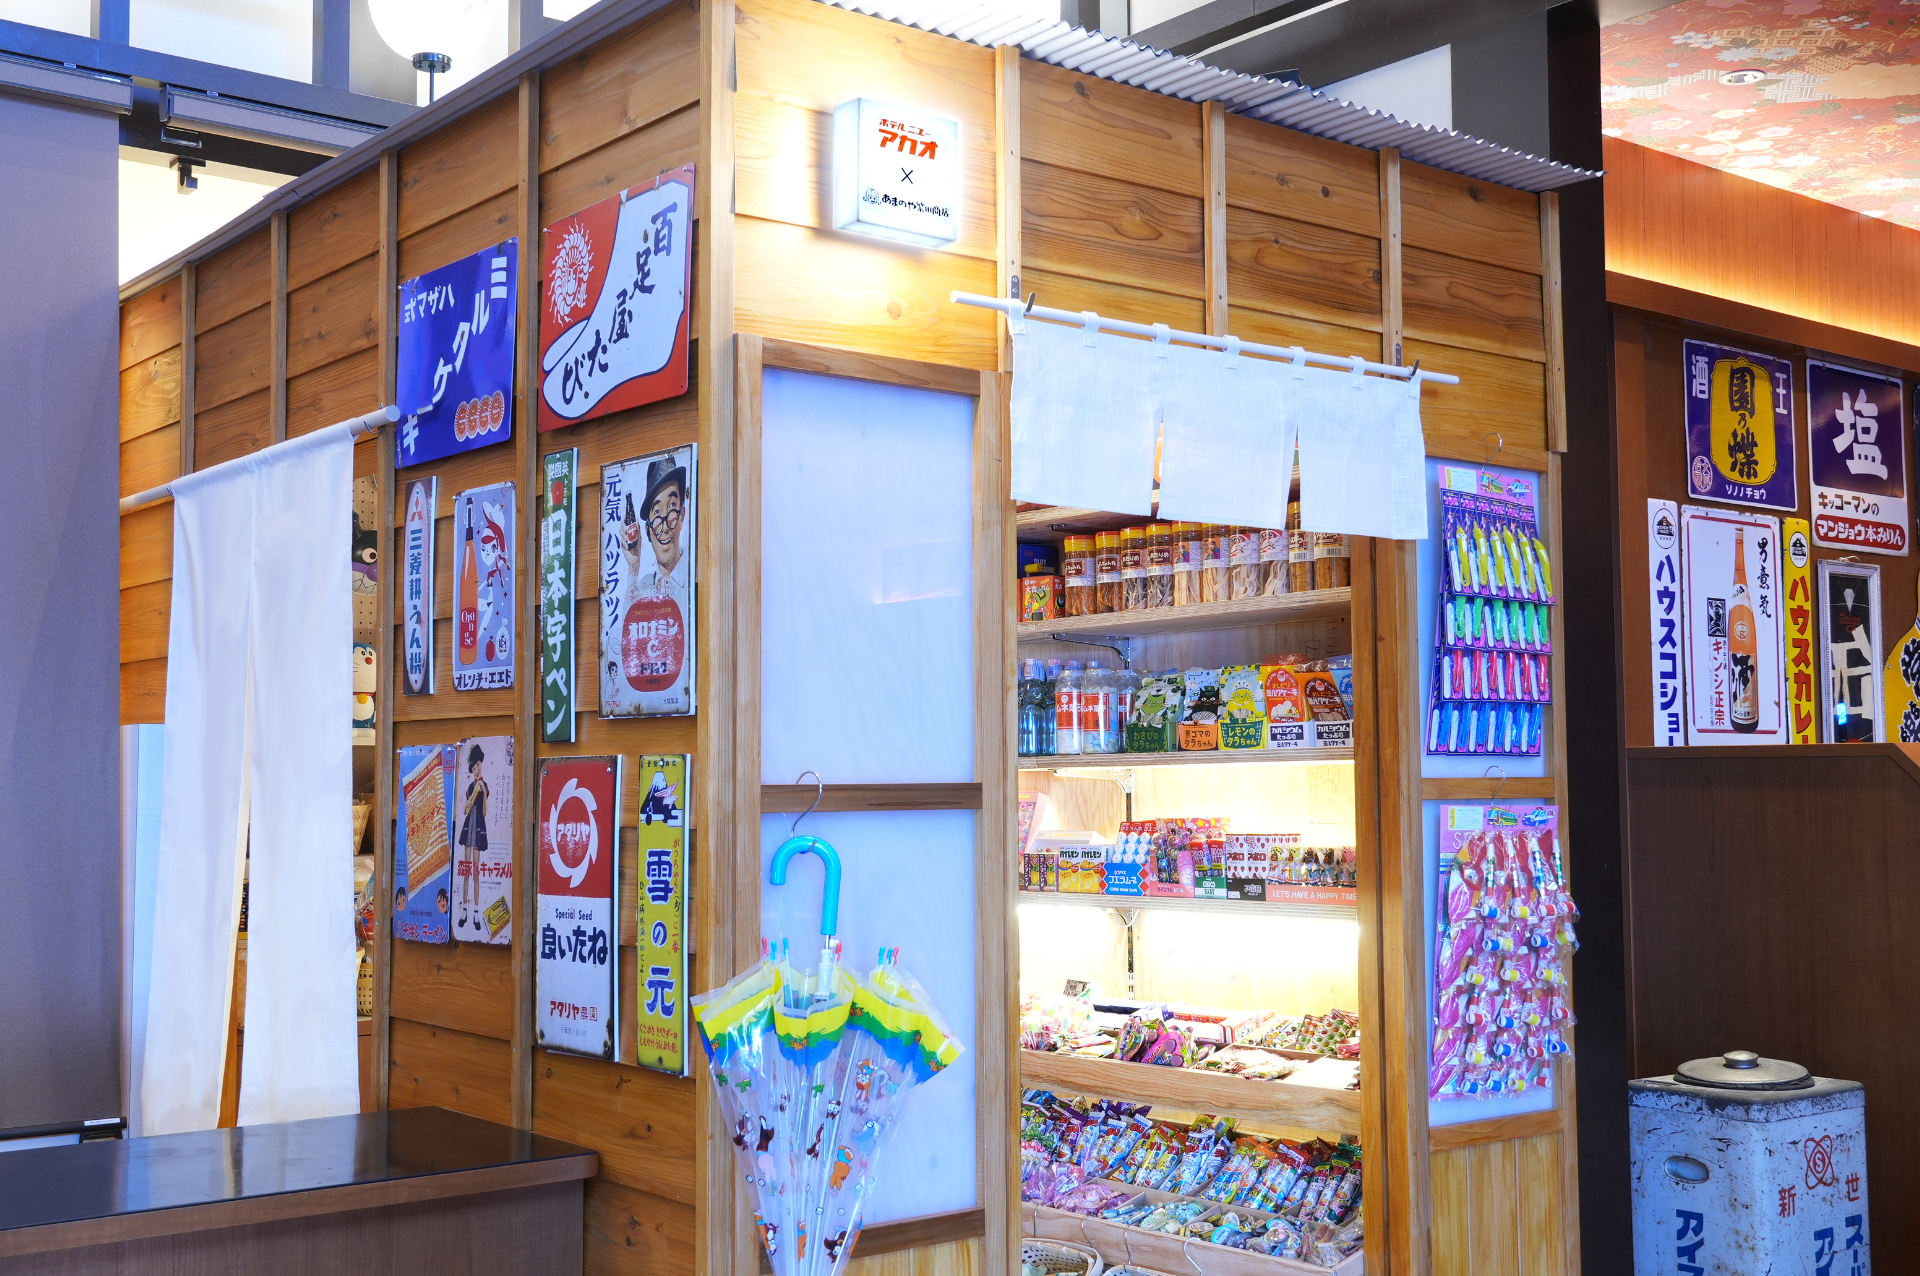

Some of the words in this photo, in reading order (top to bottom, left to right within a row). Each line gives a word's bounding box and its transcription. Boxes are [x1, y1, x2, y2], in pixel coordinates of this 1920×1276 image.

[878, 128, 938, 160] アカオ
[1692, 355, 1708, 400] 酒
[1832, 389, 1888, 480] 塩
[605, 473, 622, 524] 元気
[1726, 485, 1767, 500] ソノノチョウ
[1818, 492, 1880, 516] キッコーマンの
[1817, 519, 1904, 547] マンジョウ本みりん
[1042, 566, 1055, 574] CHINE
[1757, 537, 1771, 618] 男意気
[409, 528, 423, 674] 三菱耕うん機
[546, 508, 568, 735] 日本字ペン
[629, 616, 679, 639] オロナミン
[647, 639, 659, 657] C
[1713, 638, 1725, 727] キンシ正宗
[1266, 689, 1299, 697] ミルクケーキ
[1134, 731, 1159, 740] わさびの
[1185, 730, 1210, 739] 黒ゴマの
[1229, 727, 1255, 737] レモンの
[1271, 726, 1302, 734] カルシウム
[1317, 725, 1350, 733] カルシウム
[1133, 741, 1160, 750] タラちゃん
[1184, 739, 1213, 748] タラちゃん
[1227, 737, 1257, 746] タラちゃん
[557, 822, 590, 842] アタリヤ
[1060, 850, 1079, 858] ハイレモン
[1081, 850, 1101, 858] ハイレモン
[1108, 876, 1137, 884] フエラムネ
[1272, 890, 1290, 898] LET'S
[1292, 891, 1309, 899] HAVE
[1317, 892, 1339, 900] HAPPY
[1341, 893, 1357, 901] TIME
[555, 908, 575, 921] Special
[578, 909, 593, 921] Seed
[402, 922, 447, 942] チキンラーメン
[644, 848, 675, 1019] 雪の元
[541, 923, 608, 966] 良いたね
[550, 1000, 598, 1022] アタリヤ農園
[1778, 1185, 1796, 1218] 新
[1845, 1172, 1859, 1202] 世
